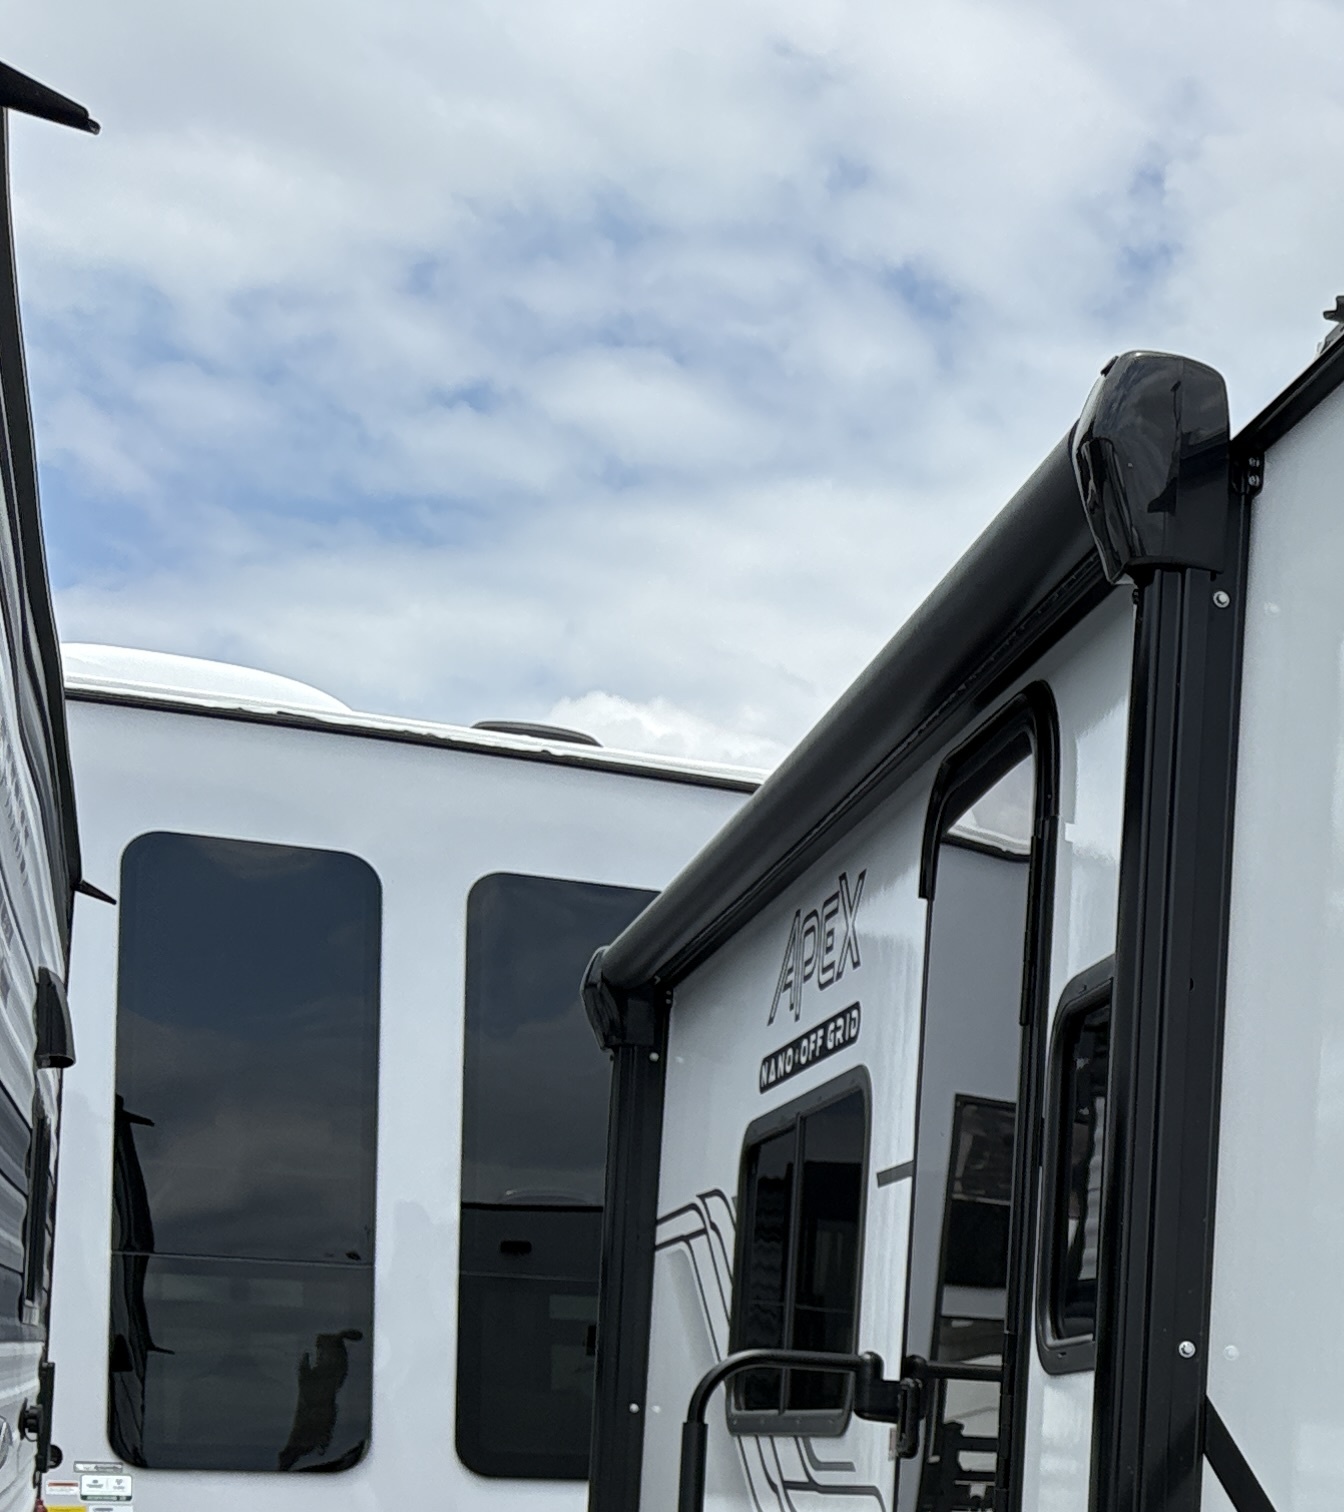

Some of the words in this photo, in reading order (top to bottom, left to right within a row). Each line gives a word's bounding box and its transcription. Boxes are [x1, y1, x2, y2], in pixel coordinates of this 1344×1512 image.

[767, 868, 867, 1026] APEX
[760, 1052, 793, 1087] NANO
[800, 1028, 824, 1066] OFF
[826, 1009, 859, 1050] GRID
